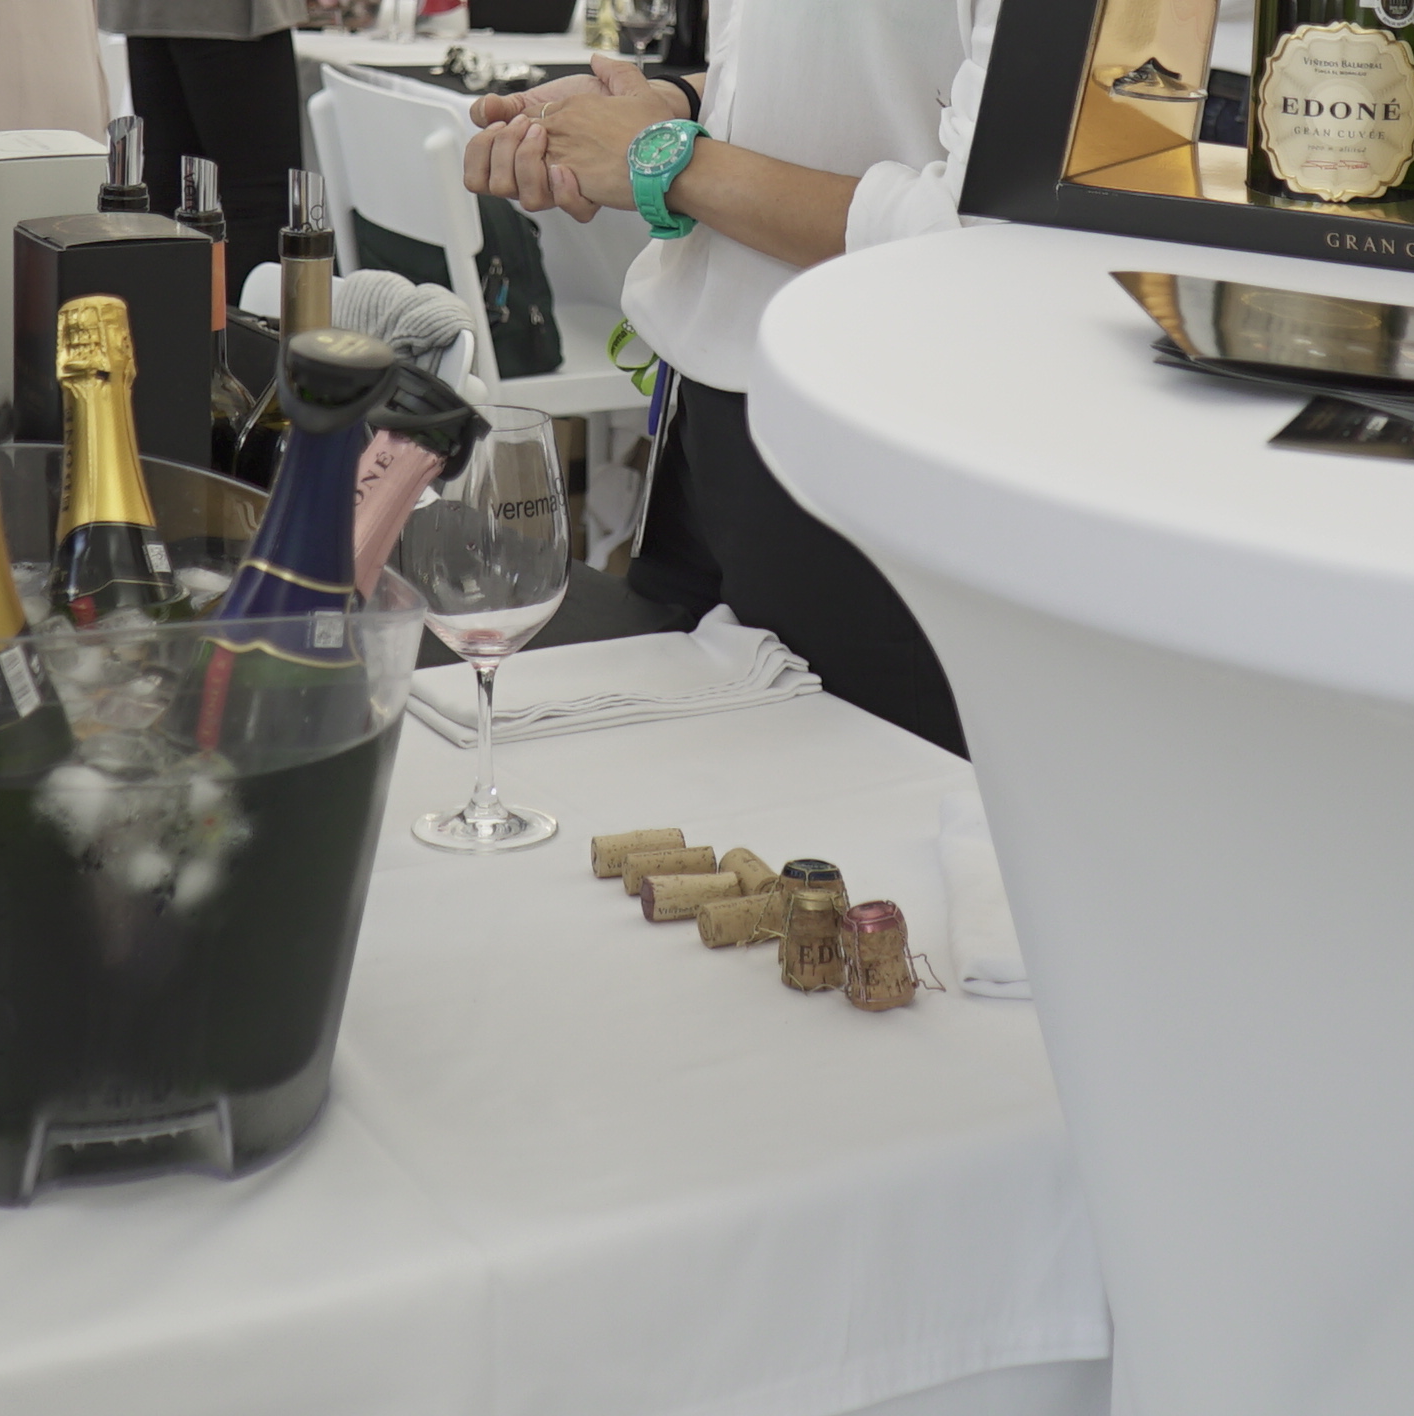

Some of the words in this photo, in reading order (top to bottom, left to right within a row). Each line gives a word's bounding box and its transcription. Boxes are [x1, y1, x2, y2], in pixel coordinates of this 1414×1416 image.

[1281, 96, 1402, 121] EDONÉ
[1293, 126, 1332, 138] GRAN
[1337, 129, 1387, 141] CUVÉE
[1326, 232, 1395, 255] GRAN
[493, 492, 559, 521] verema
